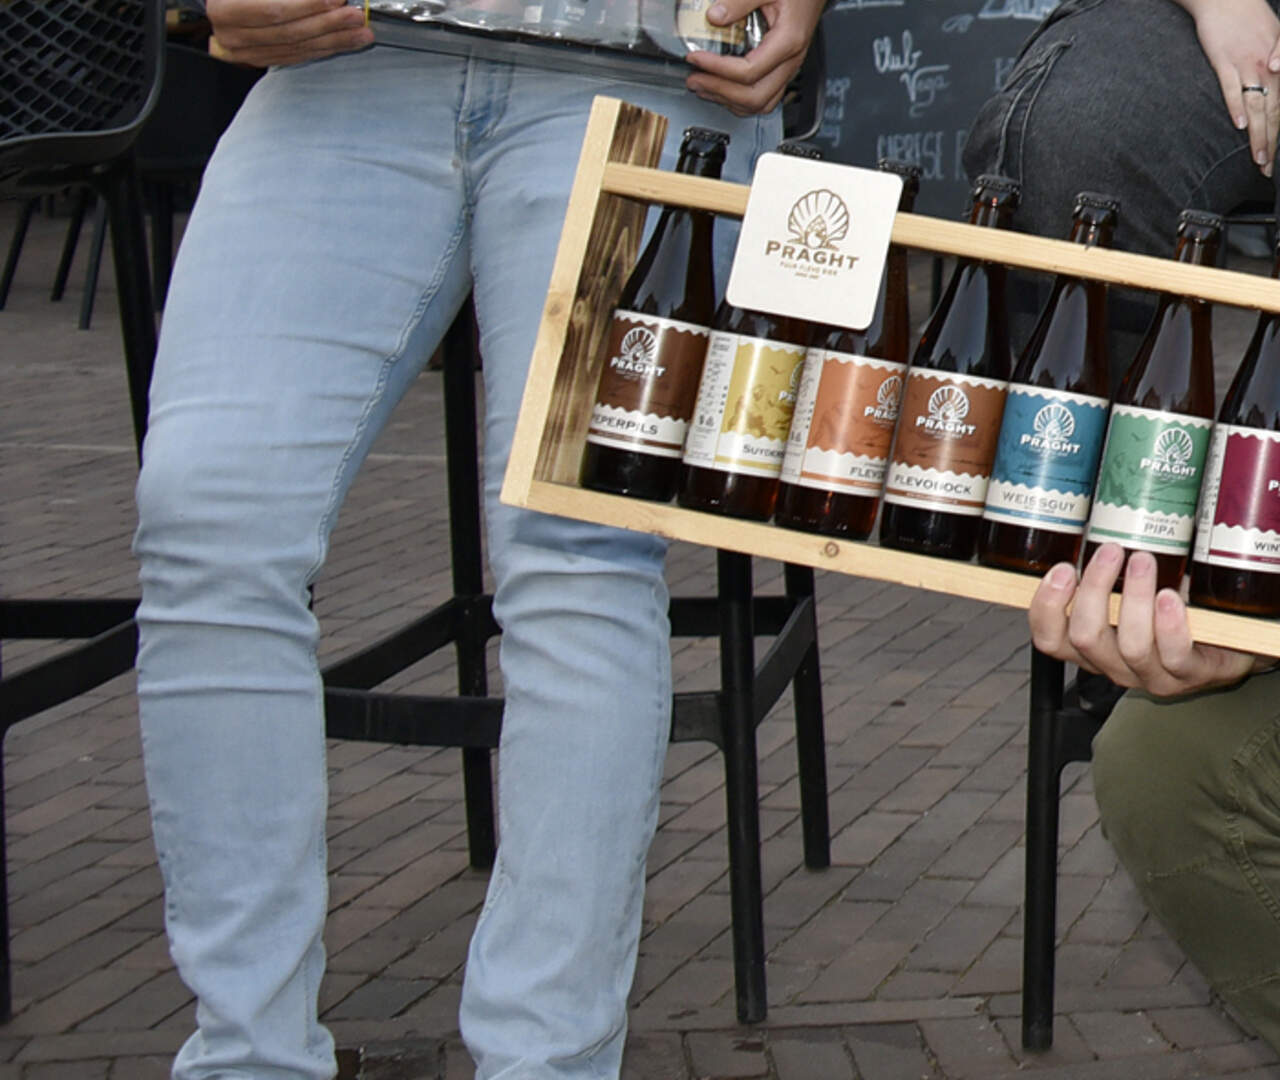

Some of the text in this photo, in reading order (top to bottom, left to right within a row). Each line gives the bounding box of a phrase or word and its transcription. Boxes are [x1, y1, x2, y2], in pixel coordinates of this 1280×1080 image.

[764, 239, 860, 270] PRAGHT
[609, 356, 666, 378] PRAGHT
[864, 405, 900, 421] PRAG
[915, 415, 977, 436] PRAGHT
[1020, 433, 1081, 454] PRAGHT
[1139, 457, 1197, 477] PRAGHT
[1143, 523, 1176, 537] PIPA
